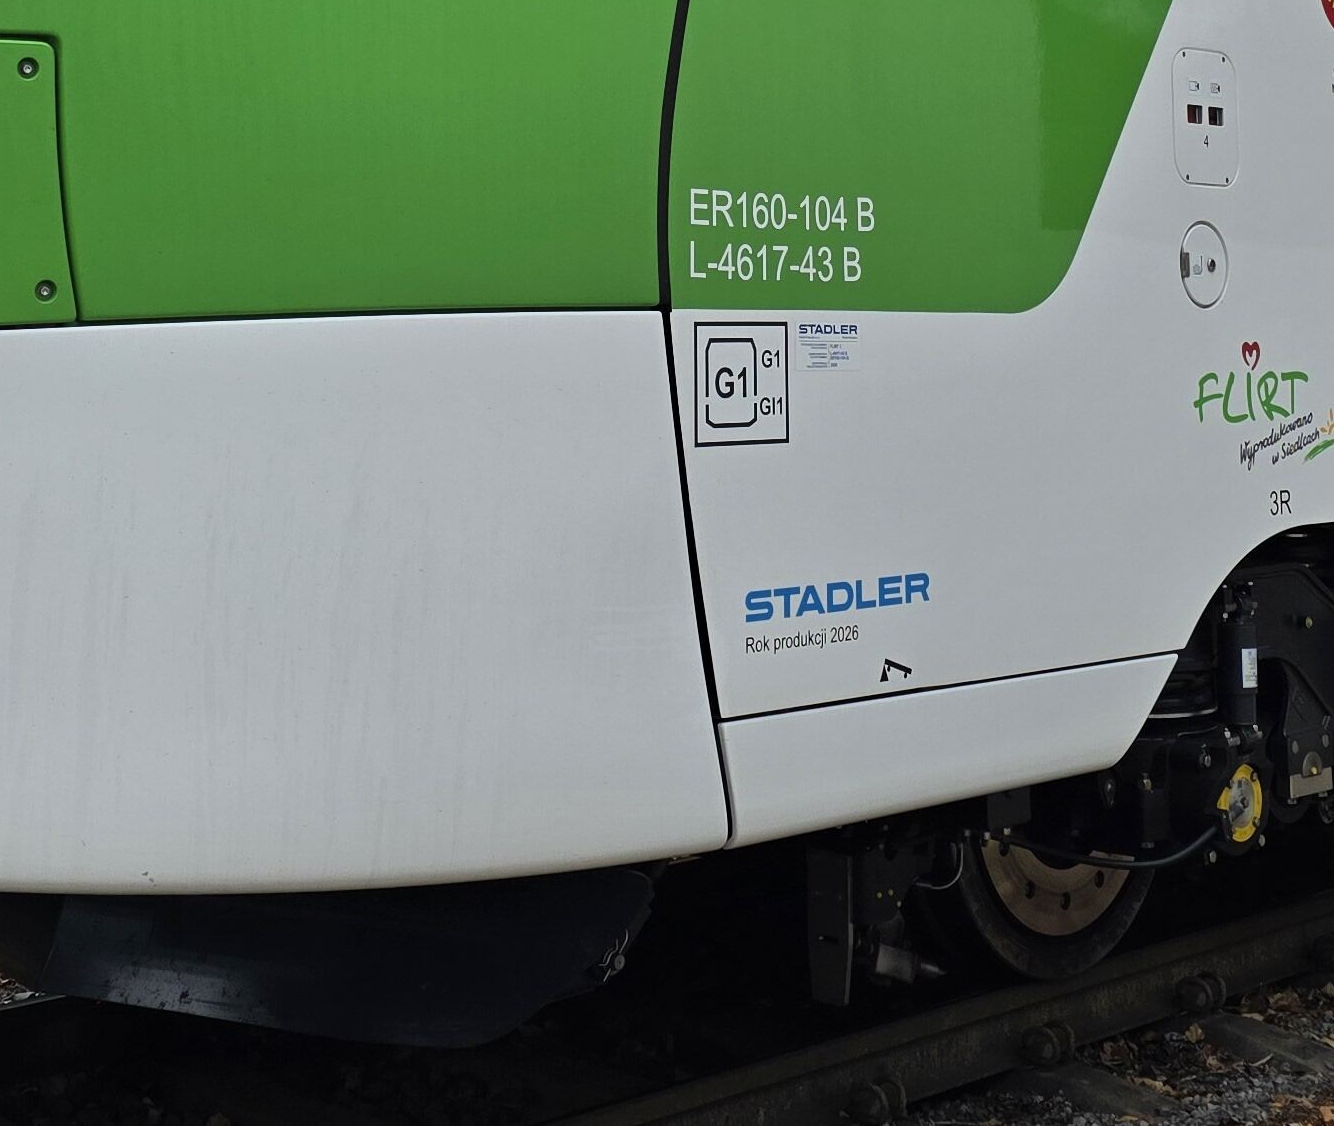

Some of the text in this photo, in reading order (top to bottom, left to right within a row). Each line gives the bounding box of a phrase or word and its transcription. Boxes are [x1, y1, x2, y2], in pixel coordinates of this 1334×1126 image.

[1203, 134, 1209, 148] 4
[690, 188, 875, 232] ER160-104 B
[689, 240, 862, 282] L-4617-43 B
[798, 323, 858, 335] STADLER
[761, 349, 780, 368] G1
[715, 366, 747, 399] G1
[1193, 370, 1309, 423] FLIRT
[1239, 412, 1314, 471] Wyprodukowano
[1271, 450, 1280, 465] w
[1269, 489, 1292, 516] 3R
[745, 572, 930, 623] STADLER
[745, 624, 860, 655] Rok produkcji 2026
